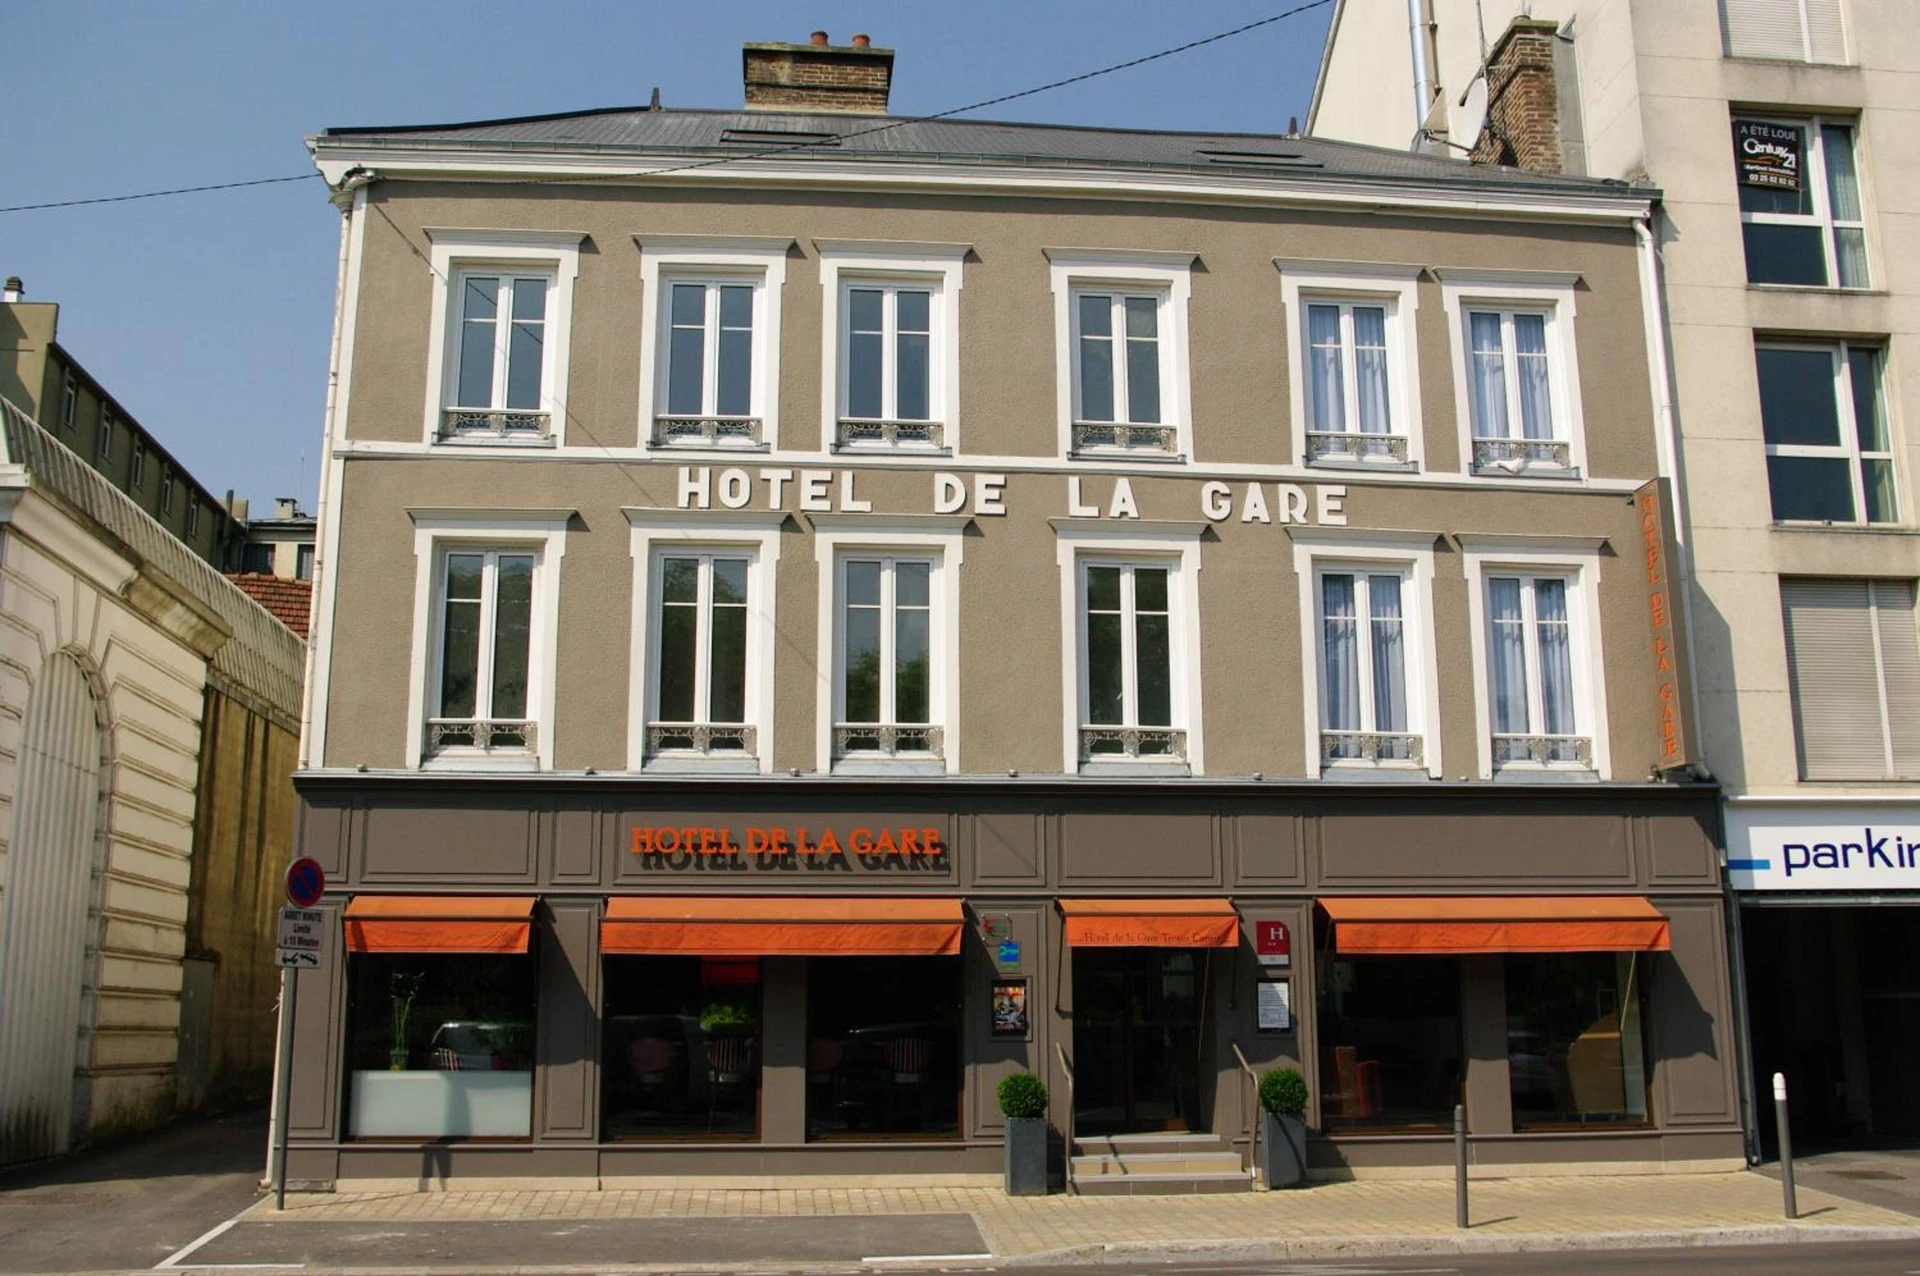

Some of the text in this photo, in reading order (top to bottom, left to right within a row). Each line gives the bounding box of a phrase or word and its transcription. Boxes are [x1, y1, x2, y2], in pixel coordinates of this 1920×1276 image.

[677, 466, 1348, 526] HOTEL DE LA GARE
[631, 827, 942, 856] HOTEL DE LA GARE
